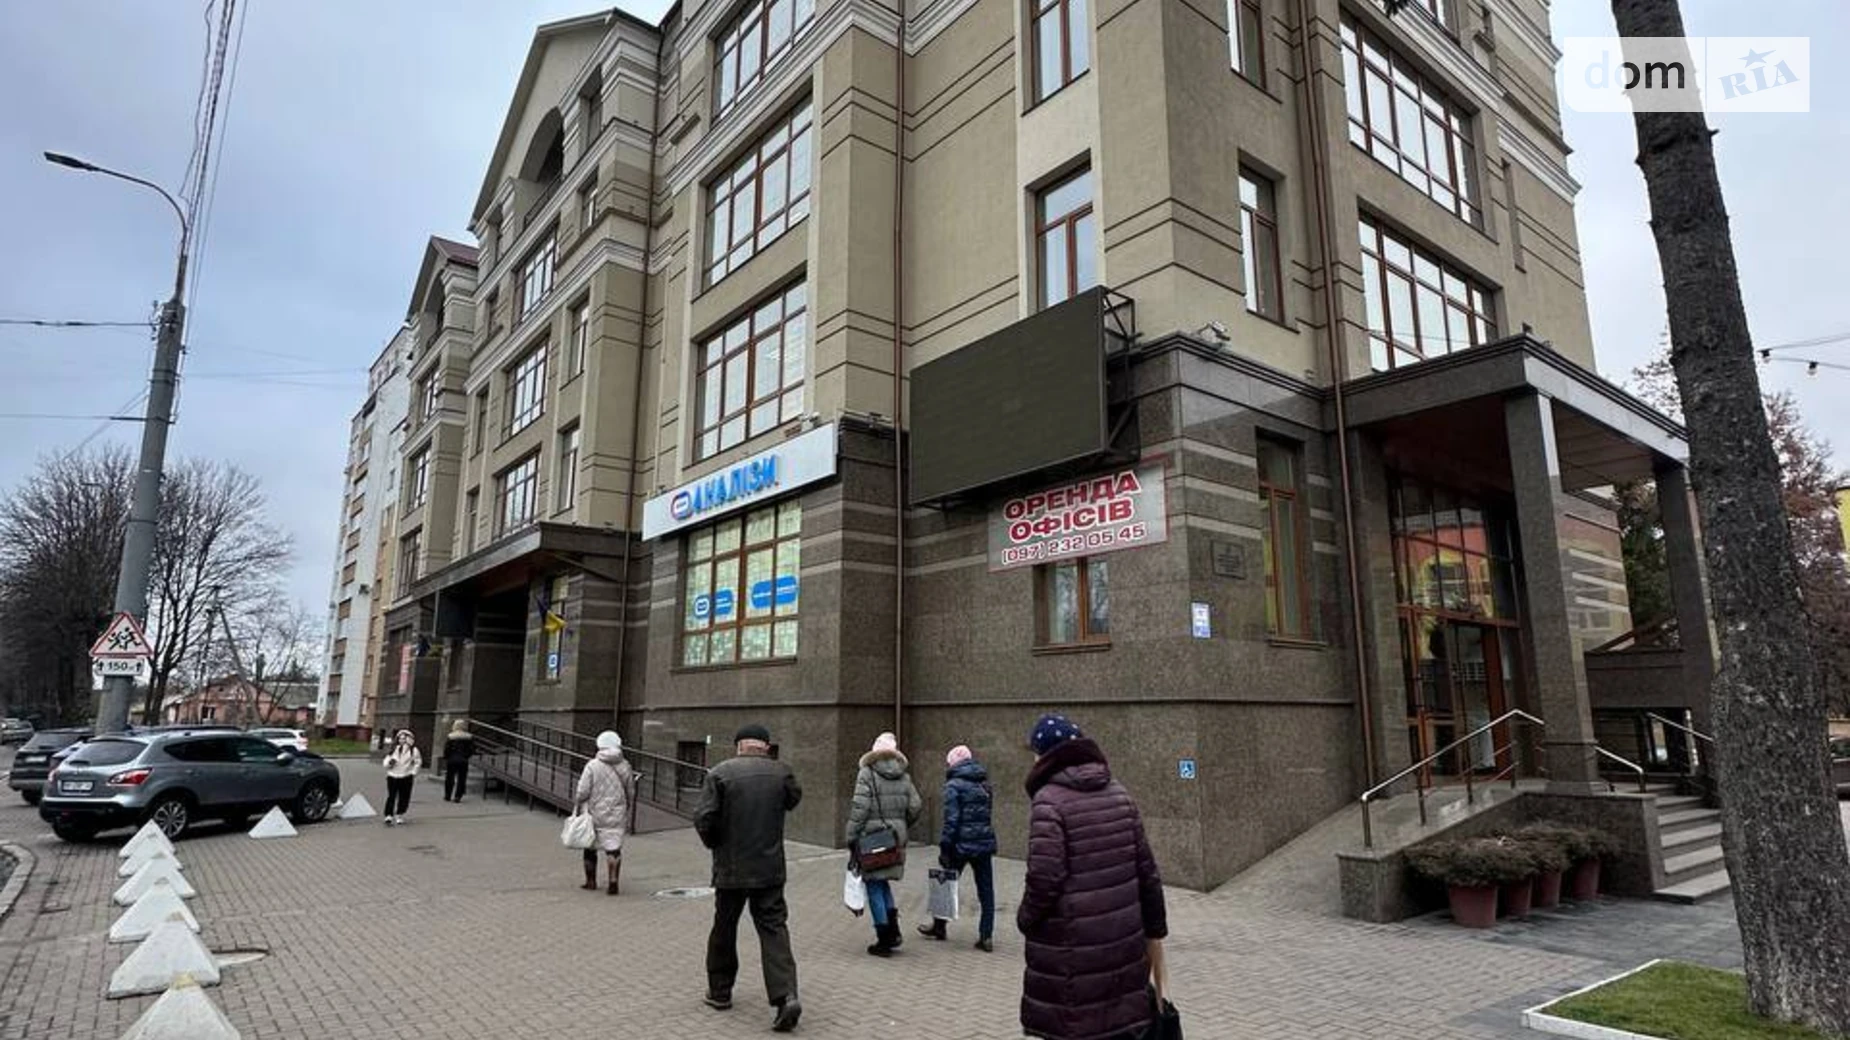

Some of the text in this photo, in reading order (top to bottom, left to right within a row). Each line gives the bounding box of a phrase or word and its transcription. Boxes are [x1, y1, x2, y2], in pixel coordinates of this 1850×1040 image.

[693, 454, 777, 514] АНАЛІЗИ
[1004, 471, 1141, 520] ОРЕНДА
[1010, 498, 1134, 542] ОФІСІВ
[1002, 523, 1145, 564] (097) 232 05 45
[107, 661, 128, 671] 150
